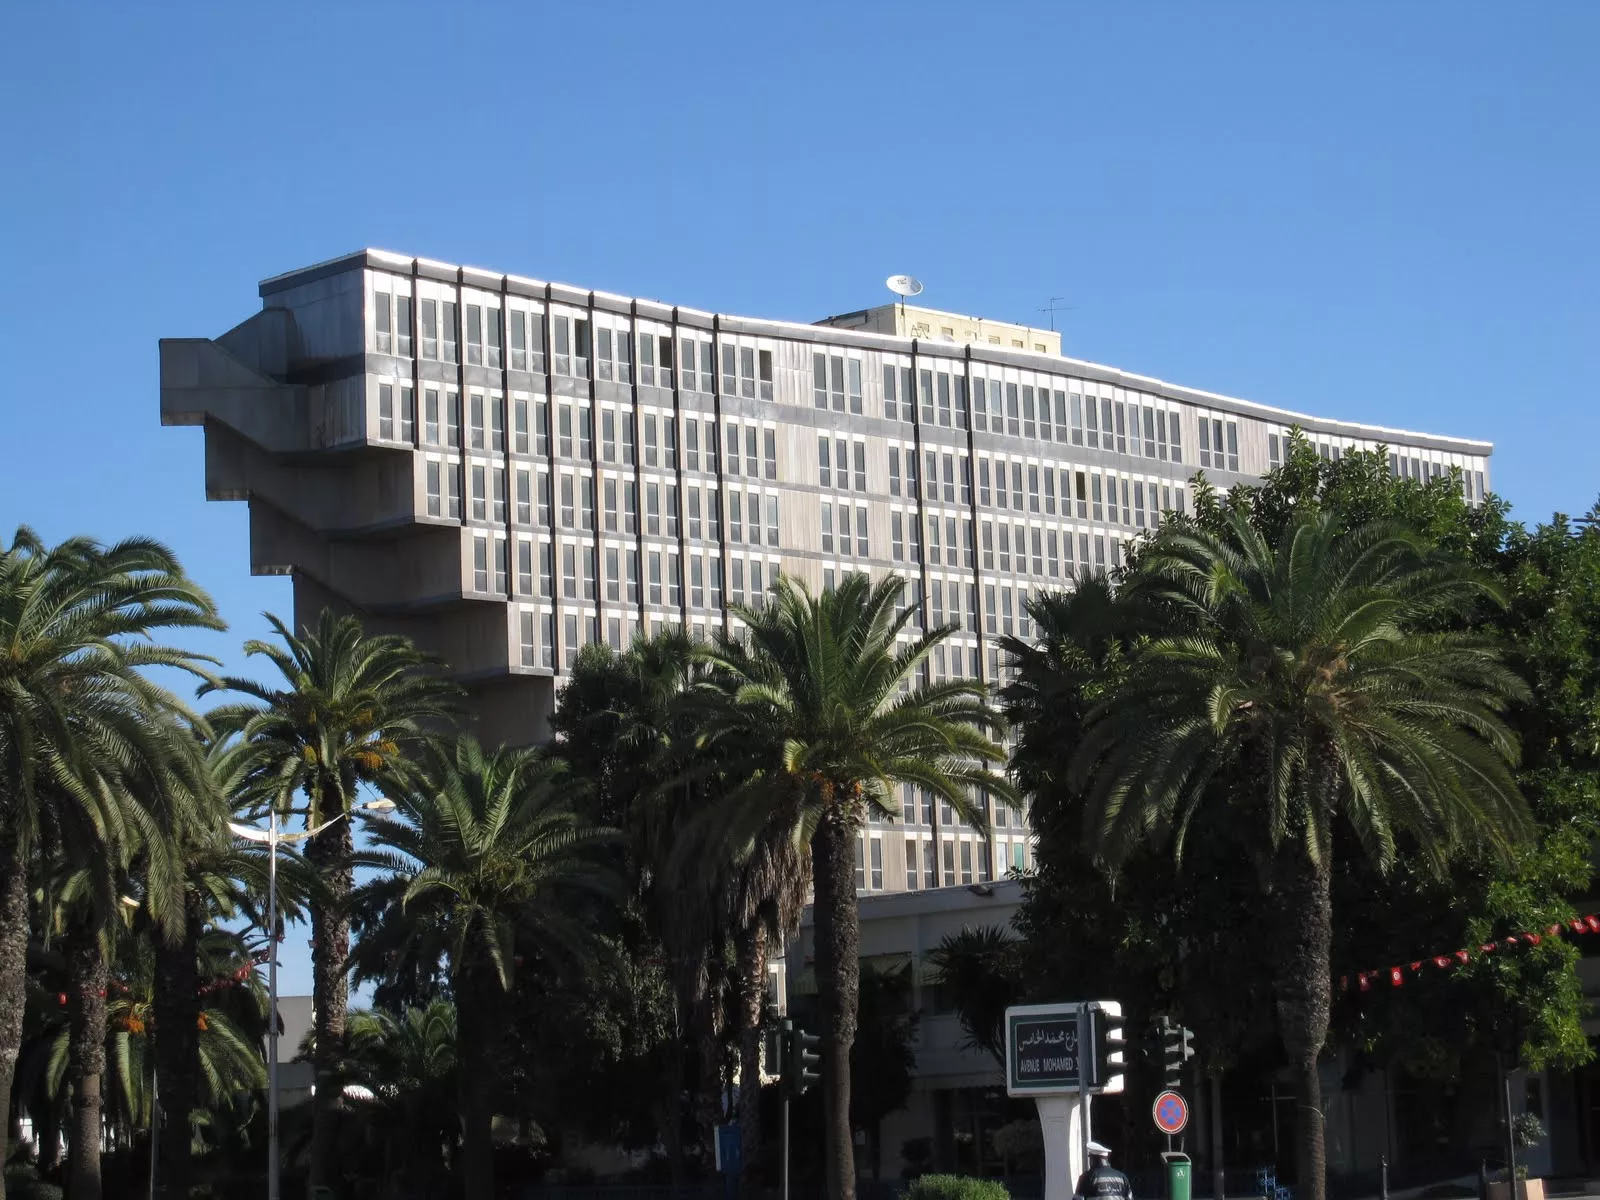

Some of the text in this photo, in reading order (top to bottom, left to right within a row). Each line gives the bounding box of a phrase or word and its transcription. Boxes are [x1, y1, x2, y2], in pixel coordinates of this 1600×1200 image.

[1018, 1029, 1078, 1052] ارع محمد الخامس
[1020, 1059, 1039, 1072] AVENUE
[1043, 1057, 1073, 1072] MOHAMED
